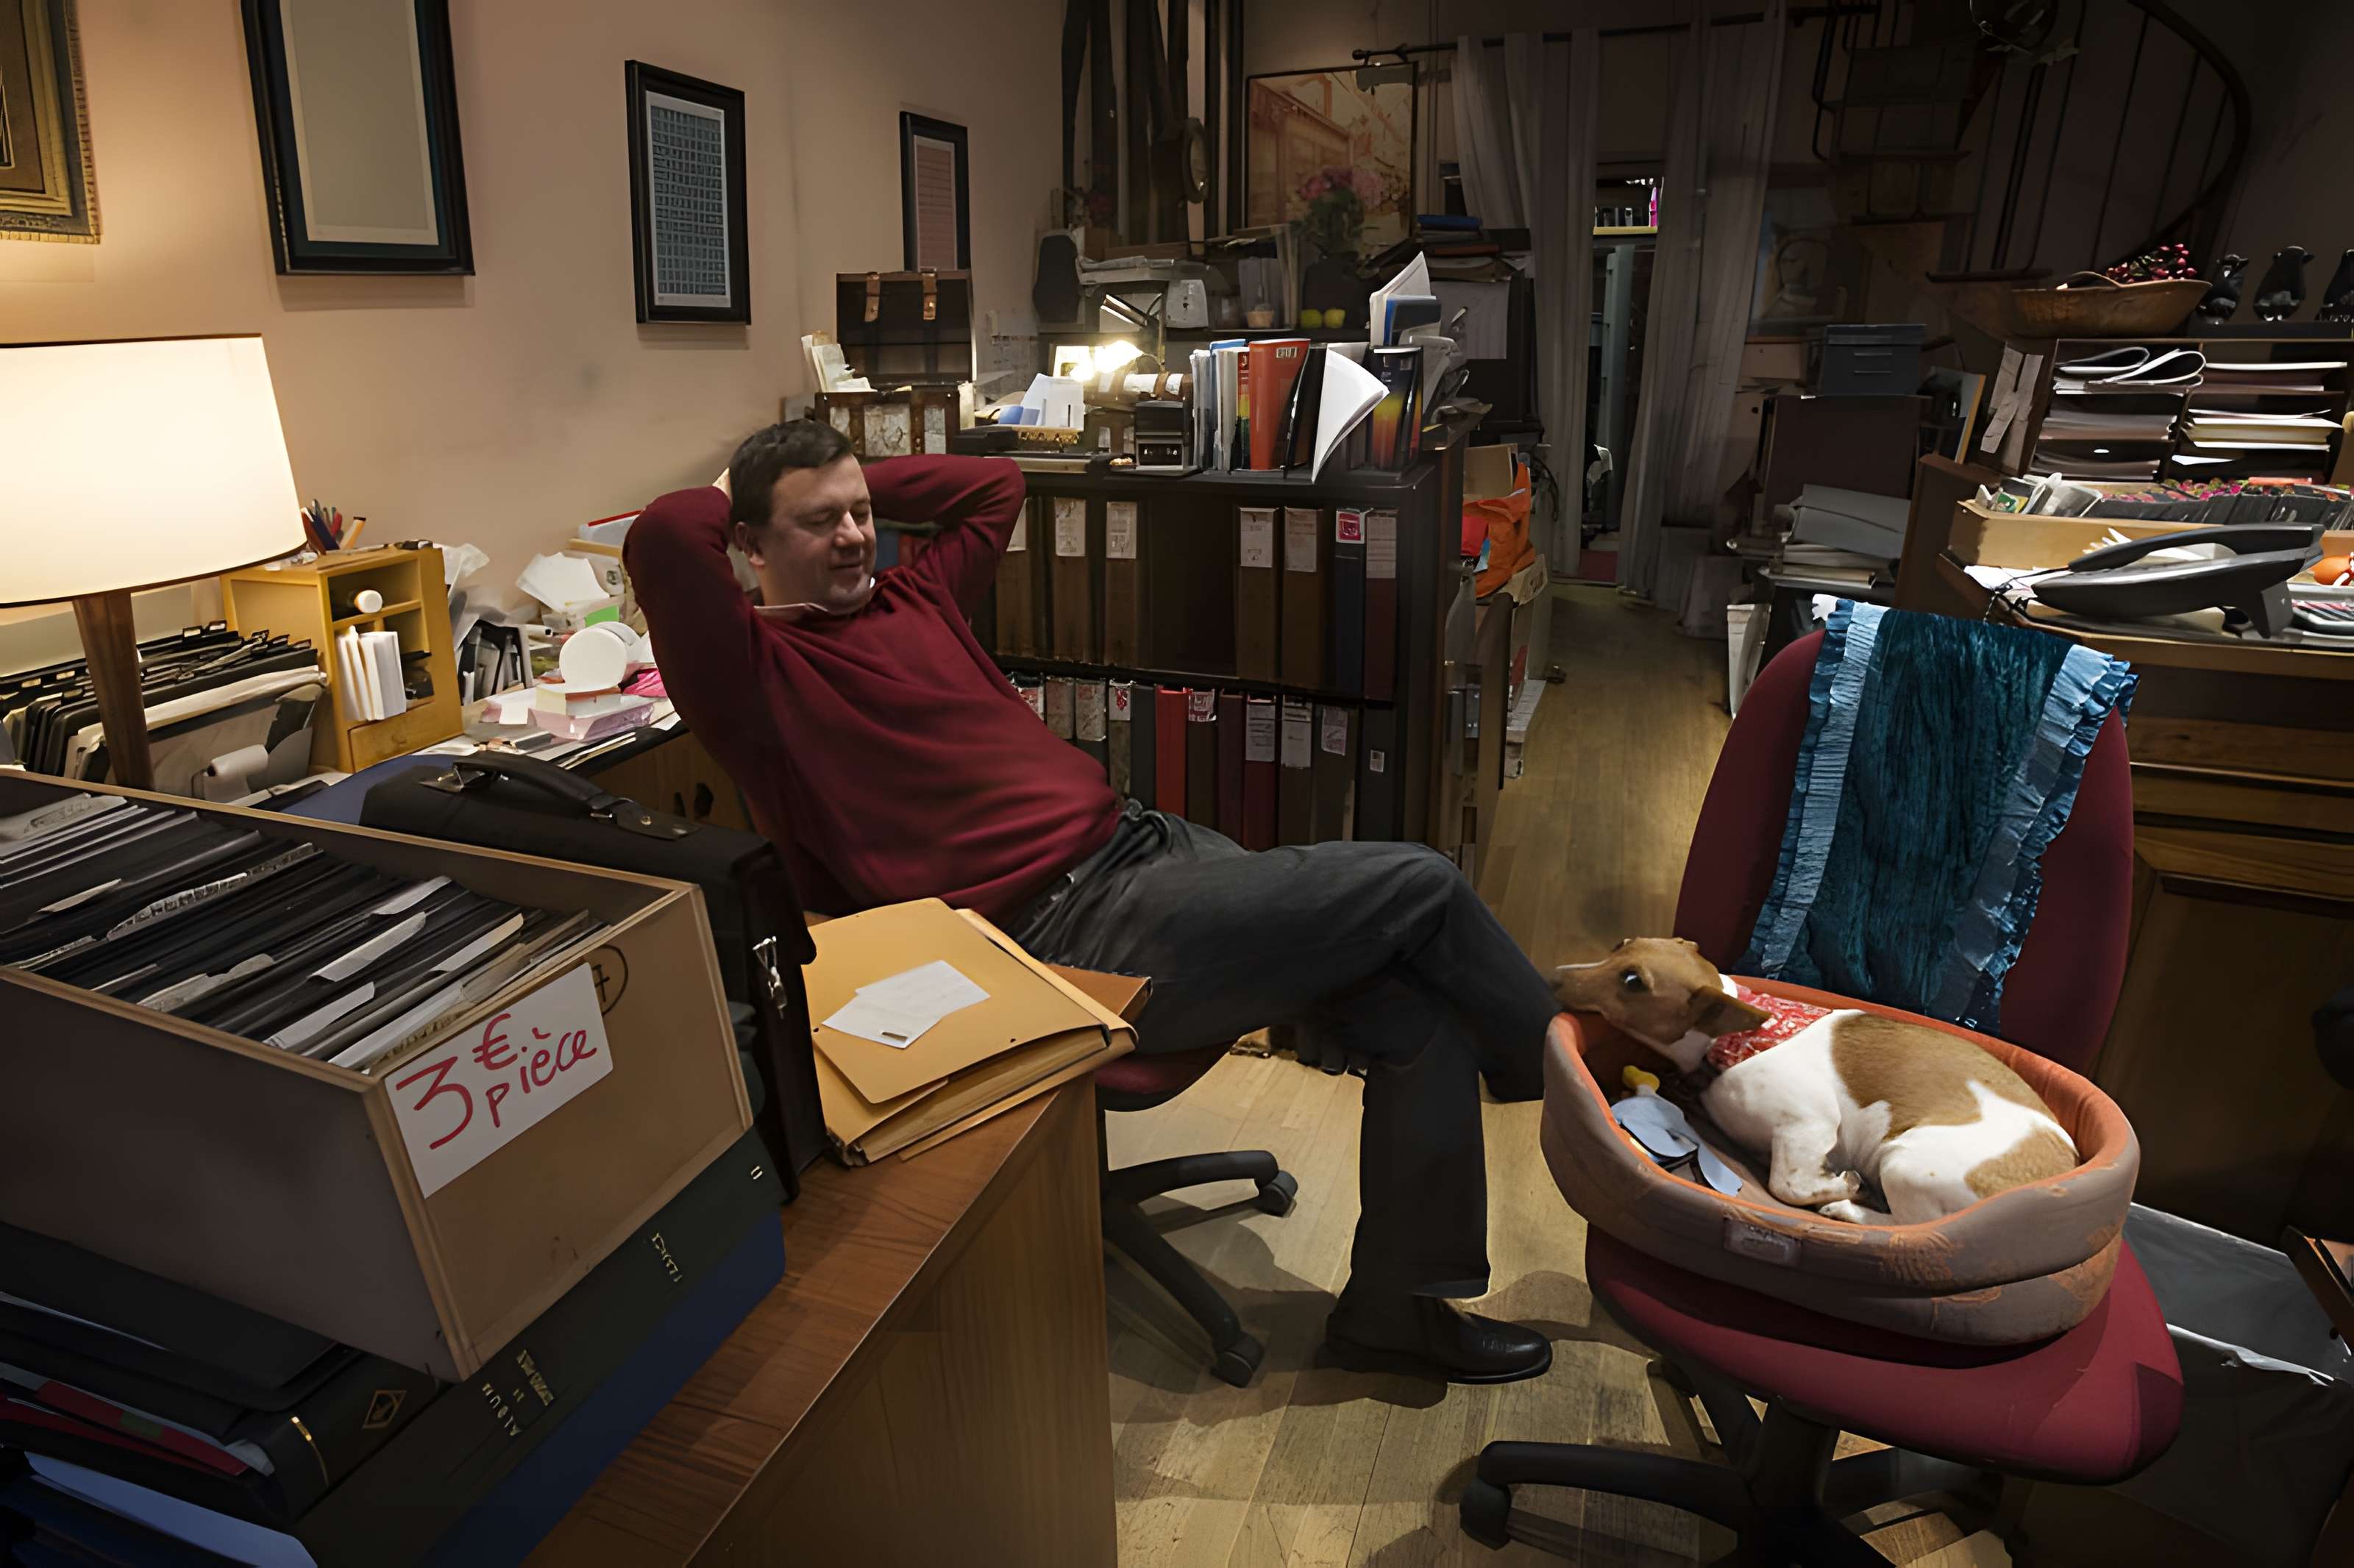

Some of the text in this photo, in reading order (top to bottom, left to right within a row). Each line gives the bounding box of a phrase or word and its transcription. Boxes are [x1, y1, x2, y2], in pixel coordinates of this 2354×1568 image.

[395, 1055, 474, 1150] 3
[472, 1013, 518, 1071] €
[485, 1027, 597, 1128] pièce
